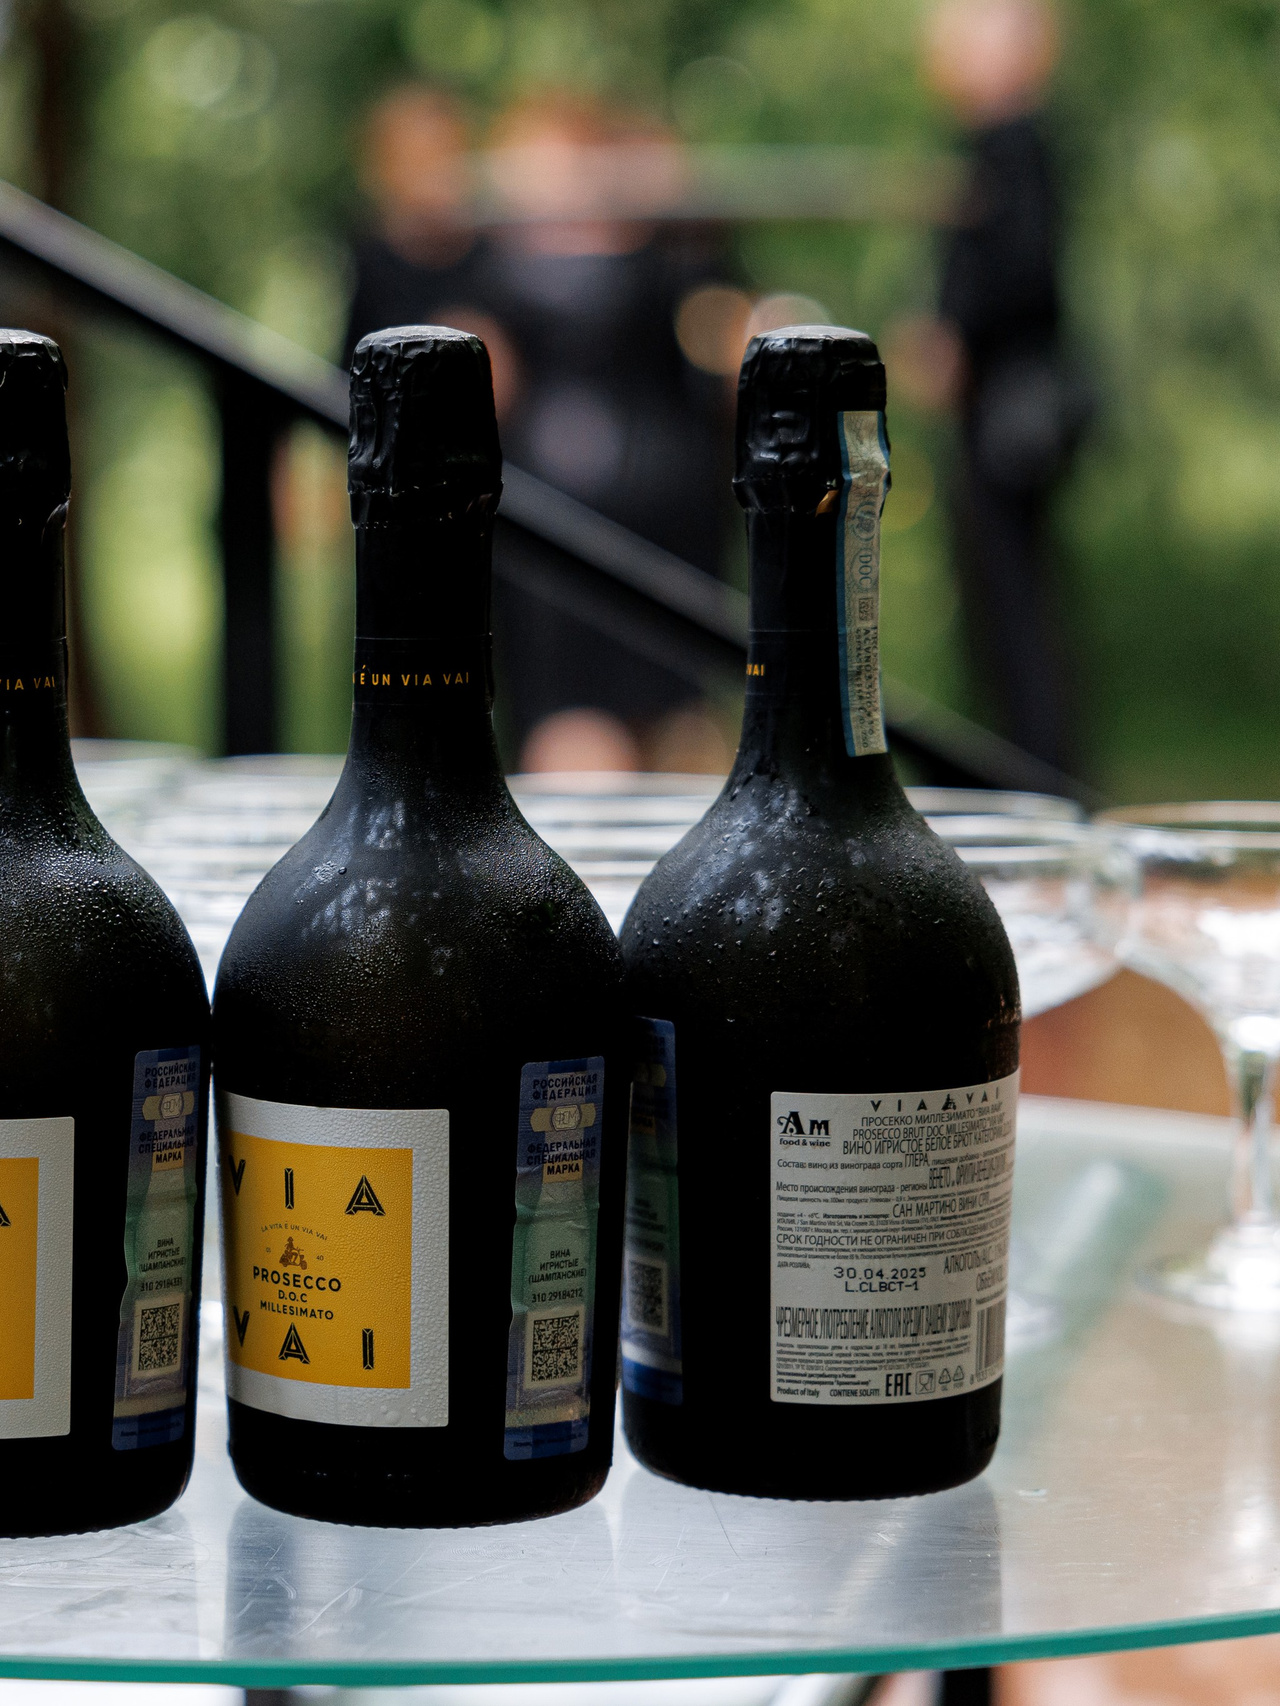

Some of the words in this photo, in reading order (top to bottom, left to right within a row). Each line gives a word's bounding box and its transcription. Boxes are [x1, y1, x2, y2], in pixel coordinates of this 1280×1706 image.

[857, 553, 874, 587] DOC
[33, 675, 56, 689] VAI
[360, 664, 366, 685] É
[371, 673, 391, 686] UN
[401, 674, 432, 686] VIA
[442, 671, 469, 685] VAI
[144, 1060, 196, 1078] РОССИЙСКАЯ
[144, 1073, 196, 1089] ФЕДЕРАЦИЯ
[532, 1073, 598, 1090] РОССИЙСКАЯ
[532, 1085, 597, 1101] ФЕДЕРАЦИЯ
[870, 1098, 928, 1113] VIA
[966, 1086, 999, 1105] VAI
[861, 1115, 913, 1127] ПРОСЕККО
[915, 1108, 976, 1124] МИЛЛЕЗИМАТО
[139, 1125, 194, 1142] ФЕДЕРАЛЬНАЯ
[852, 1127, 901, 1141] PROSECCO
[903, 1126, 925, 1139] BRUT
[926, 1124, 944, 1138] DOC
[138, 1137, 194, 1154] СПЕЦИАЛЬНАЯ
[527, 1137, 596, 1154] ФЕДЕРАЛЬНАЯ
[779, 1138, 800, 1146] food
[801, 1138, 807, 1146] &
[809, 1139, 831, 1147] wine
[842, 1140, 872, 1155] ВИНО
[874, 1139, 923, 1155] ИГРИСТОЕ
[925, 1135, 952, 1152] БЕЛОЕ
[953, 1132, 973, 1149] БРЮТ
[155, 1150, 182, 1164] МАРКА
[526, 1148, 596, 1166] СПЕЦИАЛЬНАЯ
[546, 1162, 580, 1176] МАРКА
[777, 1159, 807, 1169] Состав:
[829, 1162, 839, 1170] из
[840, 1161, 881, 1173] винограда
[882, 1160, 903, 1171] сорта
[229, 1155, 386, 1216] VIA
[775, 1181, 799, 1192] Место
[800, 1184, 858, 1195] происхождения
[859, 1184, 895, 1194] винограда
[900, 1183, 928, 1192] регионы
[892, 1203, 913, 1218] САН
[915, 1198, 957, 1216] МАРТИНО
[302, 1226, 314, 1235] VIA
[315, 1231, 328, 1241] VAI
[776, 1233, 803, 1245] СРОК
[804, 1234, 858, 1248] ГОДНОСТИ
[860, 1236, 873, 1246] НЕ
[874, 1232, 927, 1246] ОГРАНИЧЕН
[928, 1231, 945, 1243] ПРИ
[157, 1237, 174, 1248] ВИНА
[147, 1246, 180, 1260] ИГРИСТЫЕ
[550, 1248, 571, 1259] ВИНА
[539, 1258, 579, 1271] ИГРИСТЫЕ
[253, 1265, 341, 1292] PROSECCO
[528, 1267, 587, 1285] (ШАМПАНСКИЕ)
[833, 1266, 926, 1280] 30.04.2025
[844, 1280, 919, 1293] L.CLBCT-1
[278, 1289, 308, 1303] D.O.C
[531, 1292, 547, 1303] 310
[260, 1300, 334, 1320] MILLESIMATO
[231, 1304, 374, 1370] VAI
[776, 1386, 799, 1396] Product
[799, 1387, 807, 1395] of
[806, 1387, 820, 1398] Italy
[829, 1388, 860, 1397] CONTIENE
